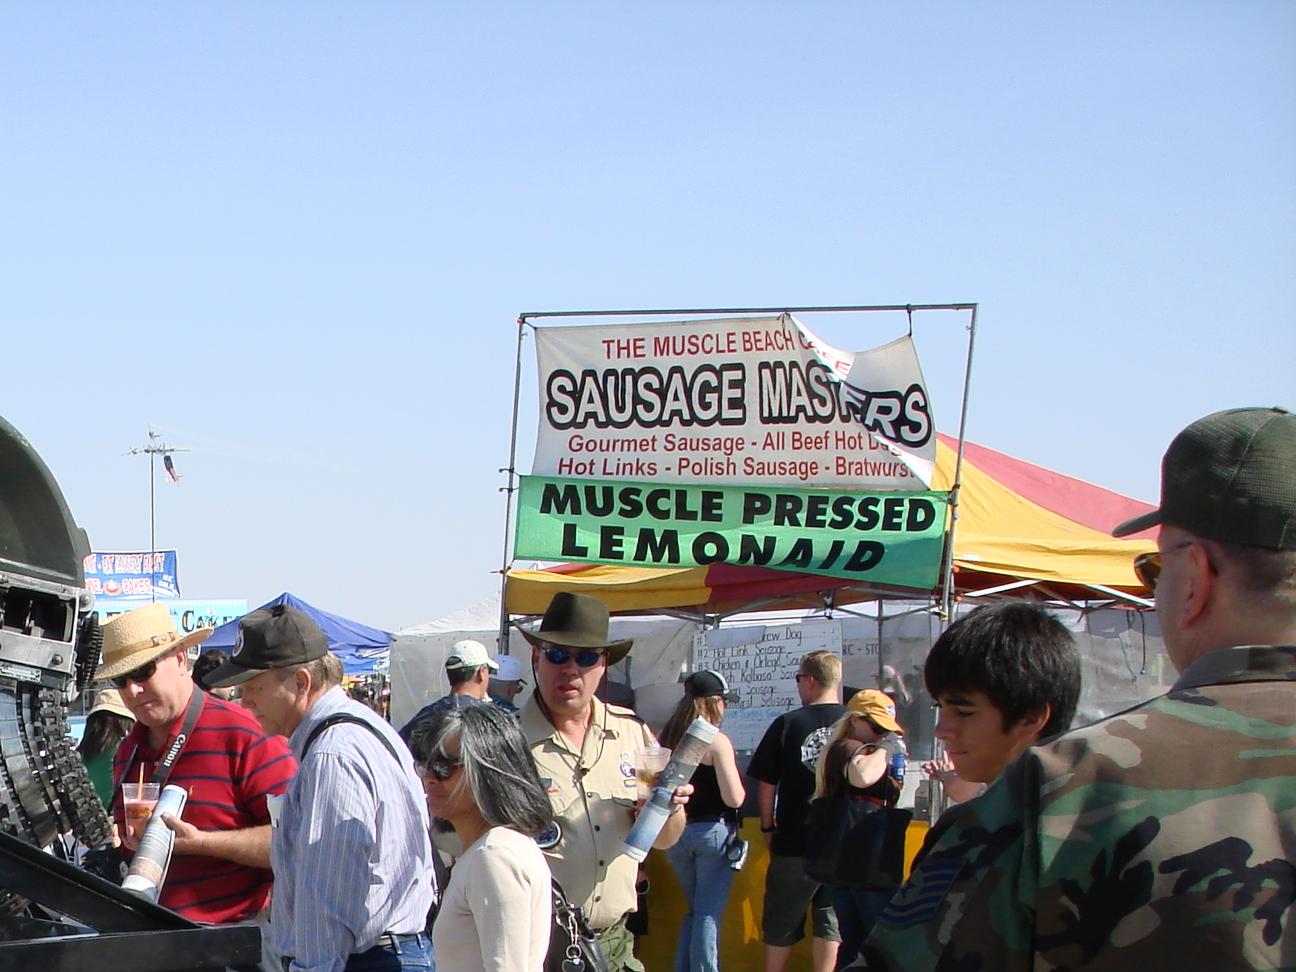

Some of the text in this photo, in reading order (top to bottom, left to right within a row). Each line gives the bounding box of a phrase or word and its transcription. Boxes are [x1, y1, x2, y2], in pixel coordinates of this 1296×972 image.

[602, 337, 646, 359] THE
[654, 332, 737, 357] MUSCLE
[742, 329, 795, 352] BEACH
[546, 363, 746, 430] SAUSAGE
[568, 434, 657, 453] Gourmet
[664, 433, 745, 456] Sausage
[762, 431, 785, 451] All
[792, 430, 830, 451] Beef
[835, 430, 863, 451] Hot
[558, 457, 596, 476] Hot
[602, 457, 658, 476] Links
[678, 457, 737, 476] Polish
[743, 457, 819, 481] Sausage
[540, 483, 936, 532] MUSCLE PRESSED
[561, 523, 886, 572] LEMONAID
[731, 644, 749, 657] Link
[755, 641, 786, 659] Sausage
[786, 627, 802, 646] Dog
[712, 654, 740, 671] Chicken
[163, 734, 186, 767] Canon
